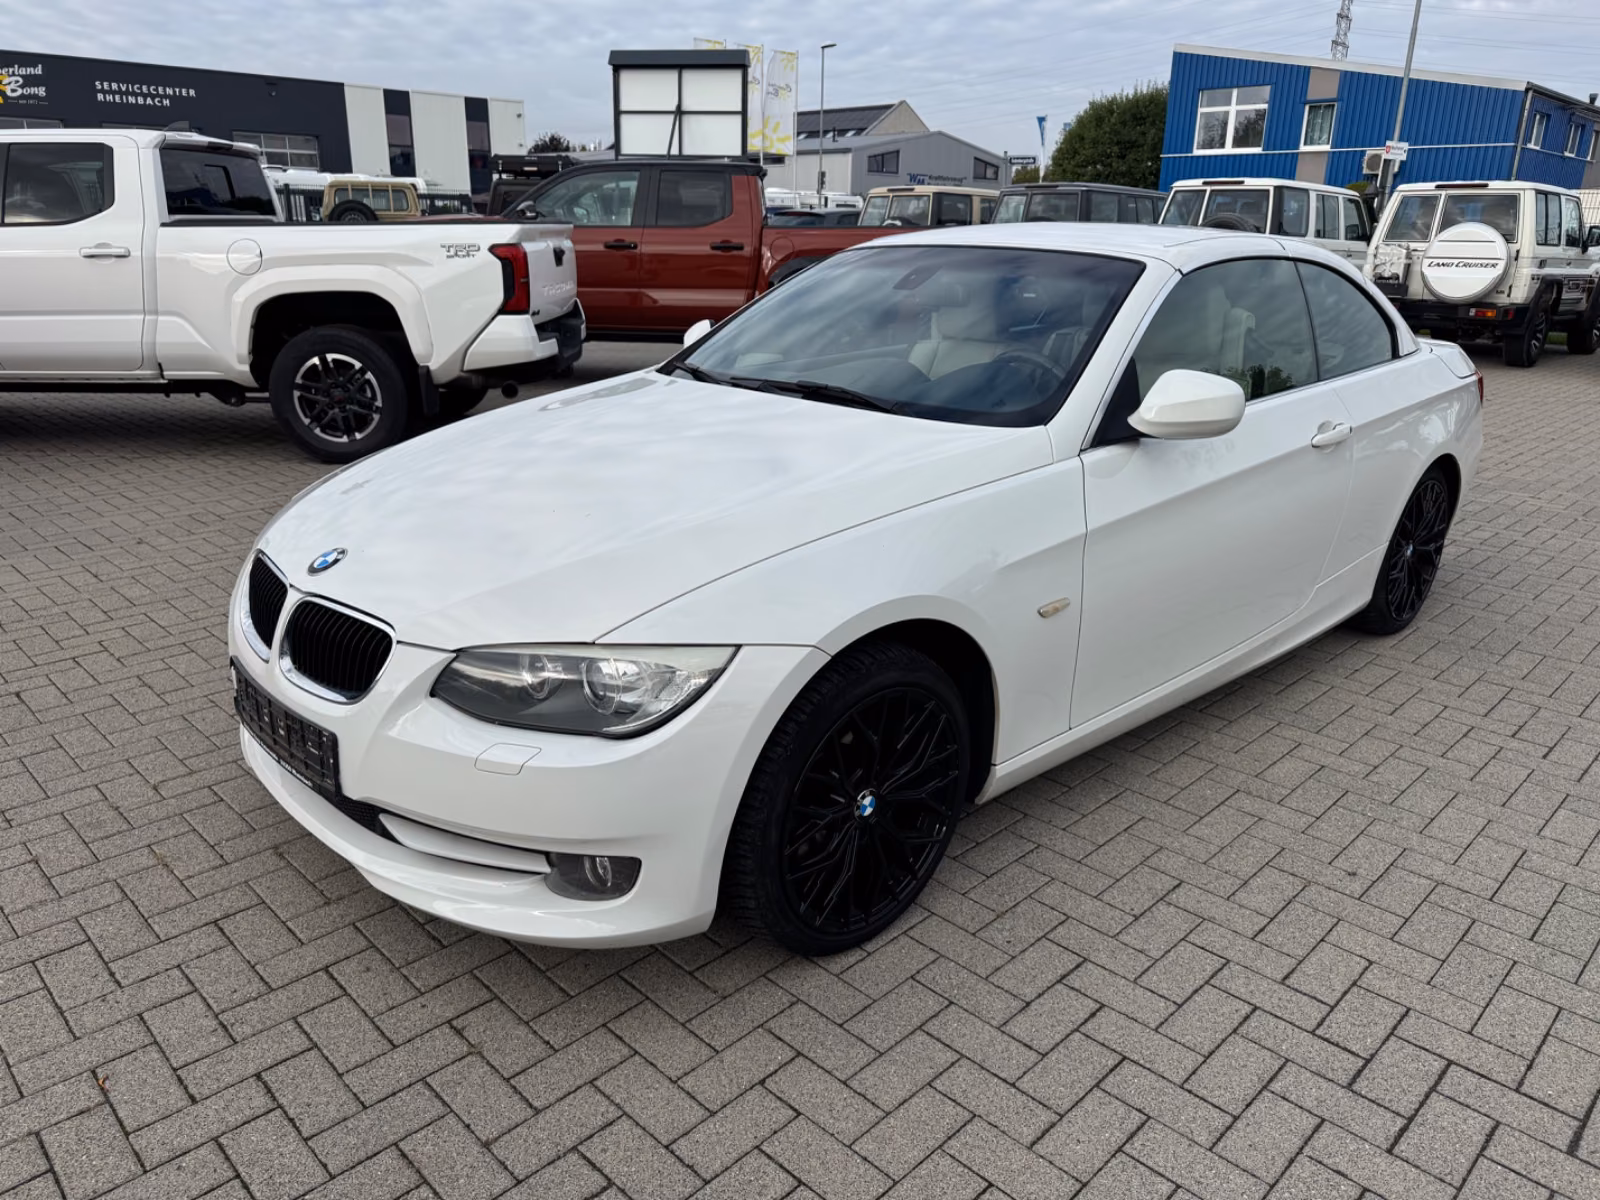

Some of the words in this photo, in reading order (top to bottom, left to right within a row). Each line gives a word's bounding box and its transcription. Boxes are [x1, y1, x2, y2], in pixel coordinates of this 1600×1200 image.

[2, 75, 47, 97] Bong
[95, 81, 197, 97] SERVICECENTER
[97, 93, 170, 107] RHEINBACH
[440, 243, 481, 254] TRD
[1427, 260, 1455, 268] LAND
[1455, 260, 1500, 269] CRUISER
